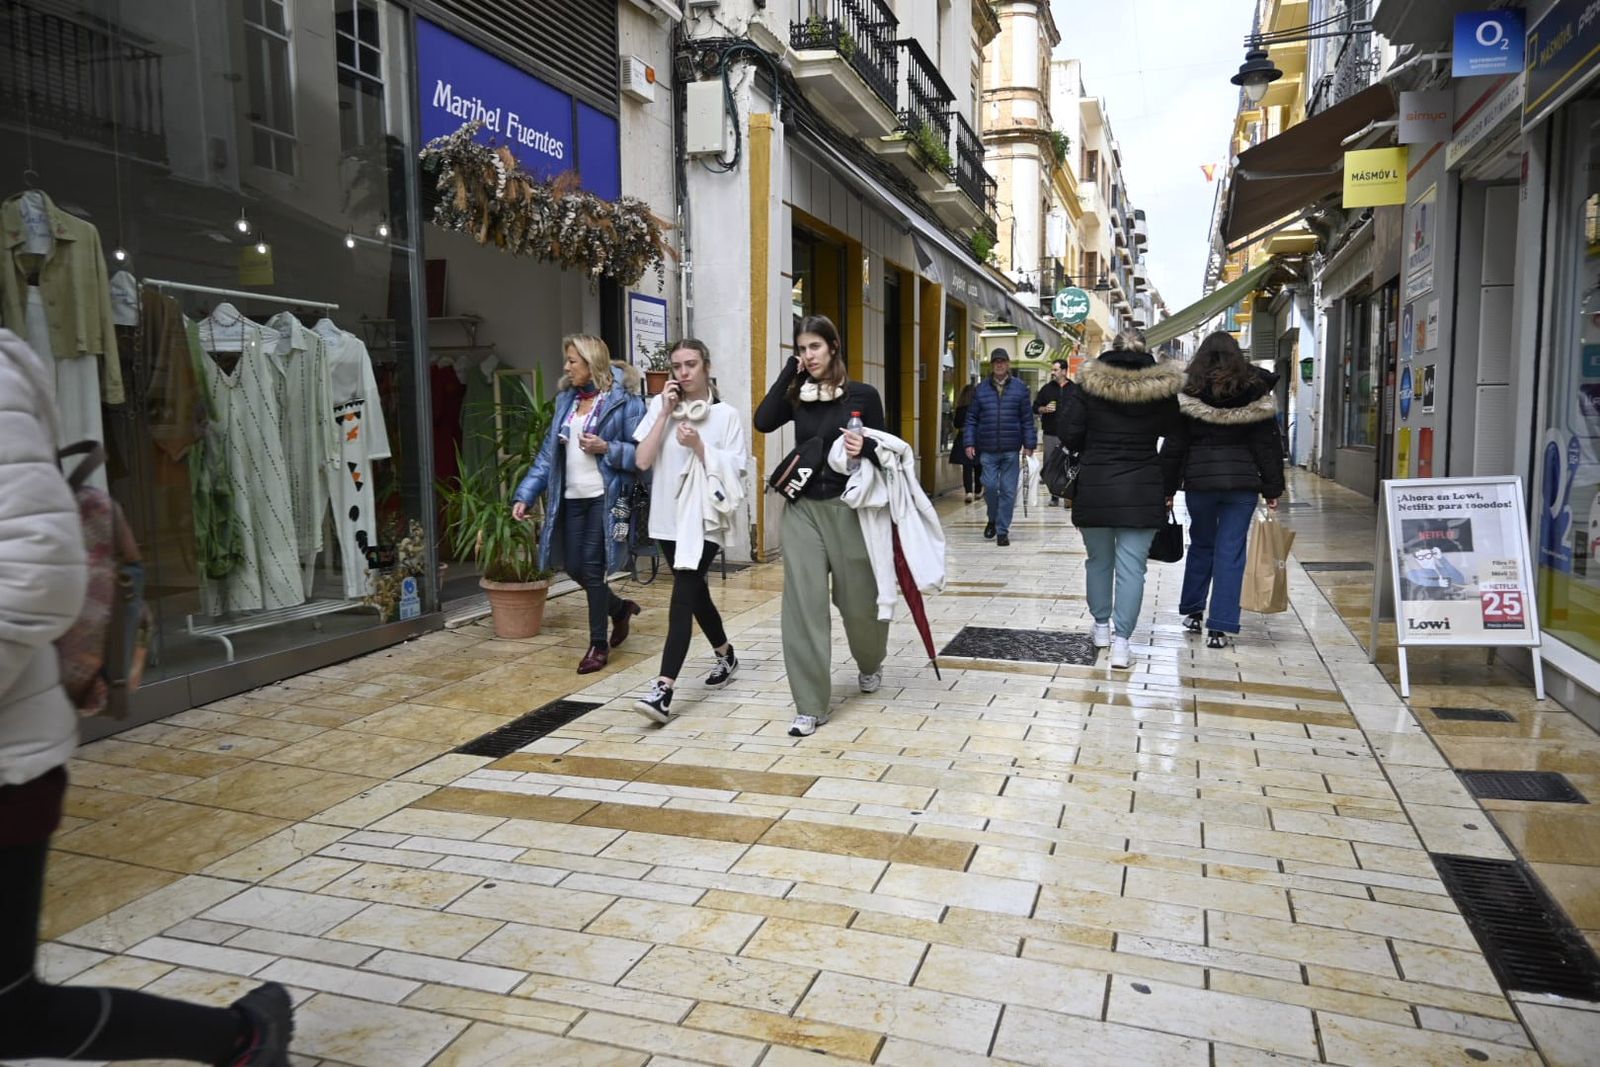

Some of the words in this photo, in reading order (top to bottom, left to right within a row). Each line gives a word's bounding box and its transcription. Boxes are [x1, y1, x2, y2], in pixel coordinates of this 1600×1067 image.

[433, 80, 500, 132] Maribel
[506, 112, 563, 160] Fuentes
[1351, 169, 1398, 181] MÁSMÓVL
[783, 467, 813, 499] FILA
[1397, 492, 1436, 503] ¡Ahora
[1453, 492, 1484, 501] Lowi,
[1398, 502, 1434, 511] Netflix
[1438, 503, 1462, 512] para
[1482, 592, 1522, 615] 25
[1408, 616, 1451, 630] Lowi
